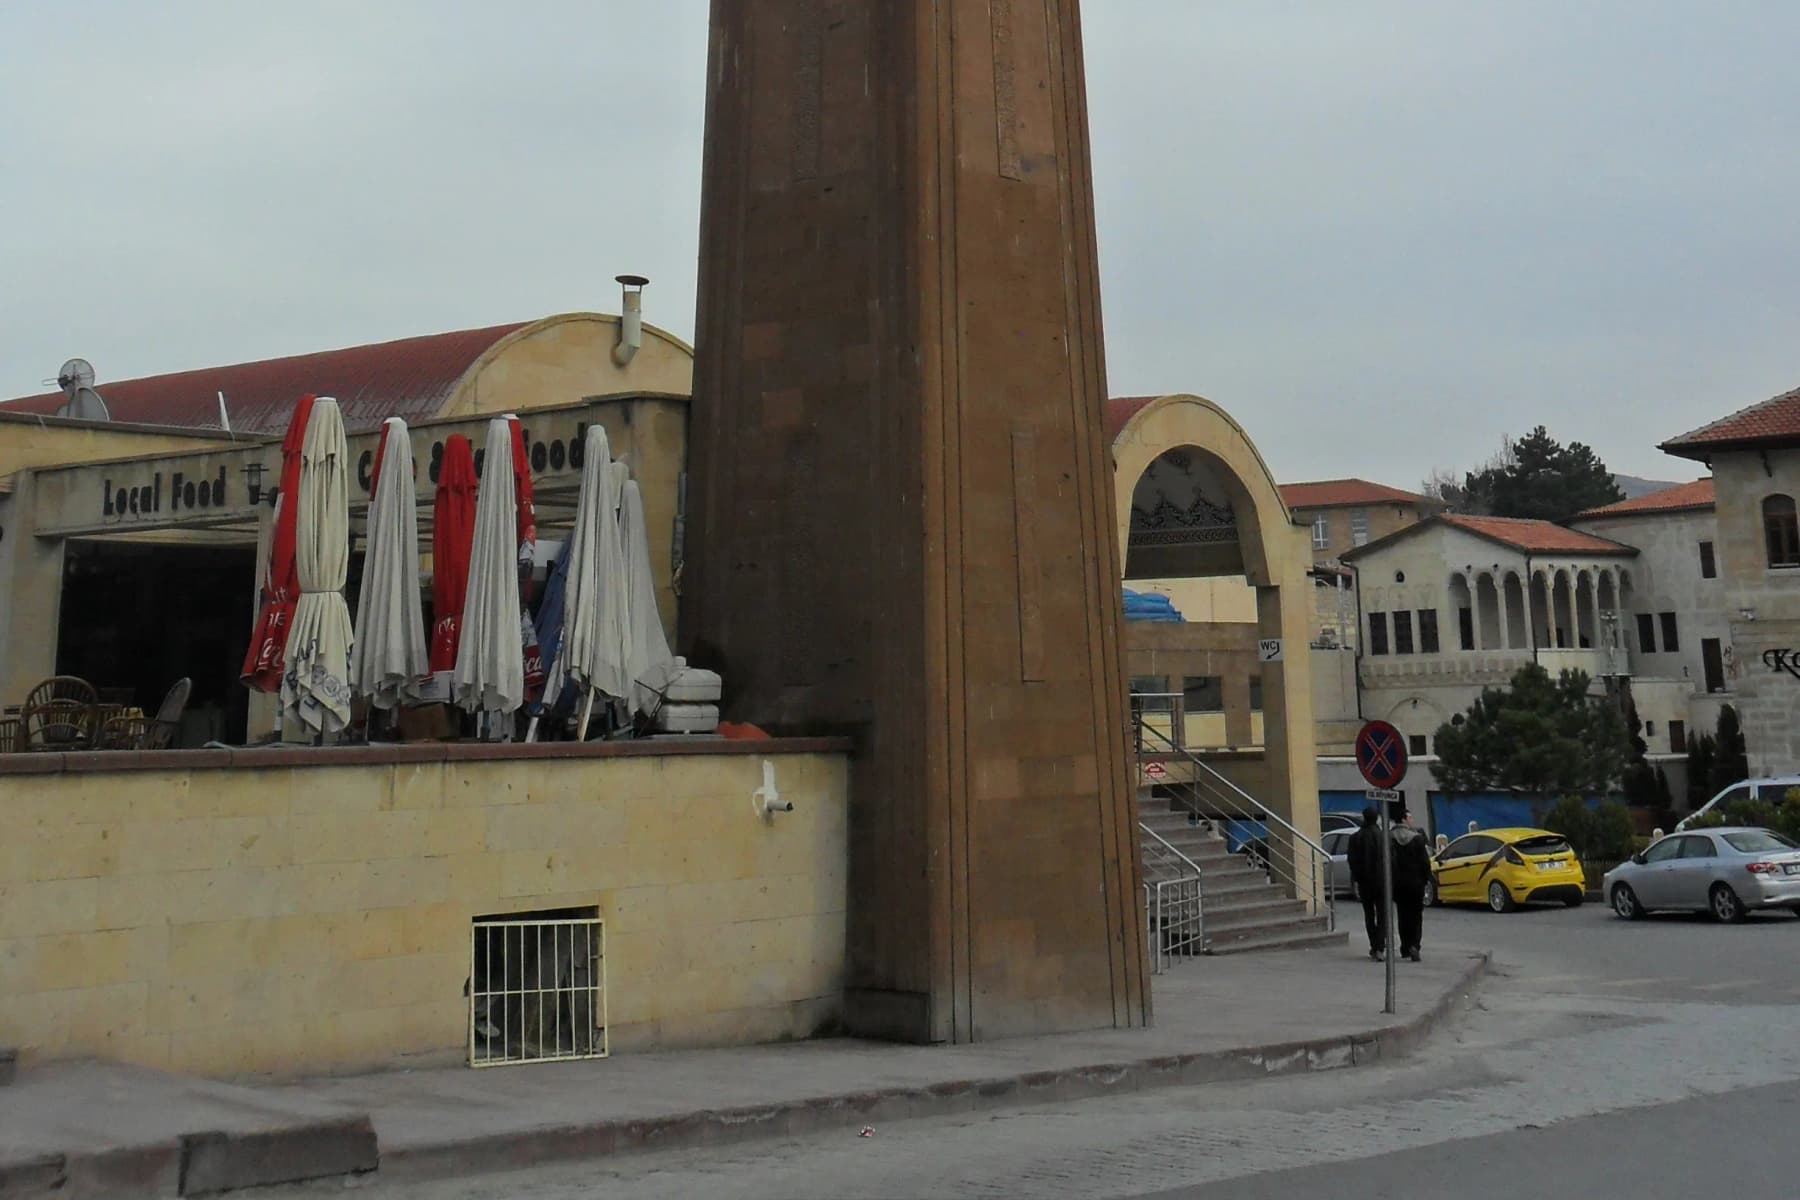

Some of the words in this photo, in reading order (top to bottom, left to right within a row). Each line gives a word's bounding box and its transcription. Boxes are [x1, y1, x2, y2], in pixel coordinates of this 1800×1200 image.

[103, 471, 161, 516] Local
[171, 464, 227, 512] Food
[1260, 640, 1277, 651] WC
